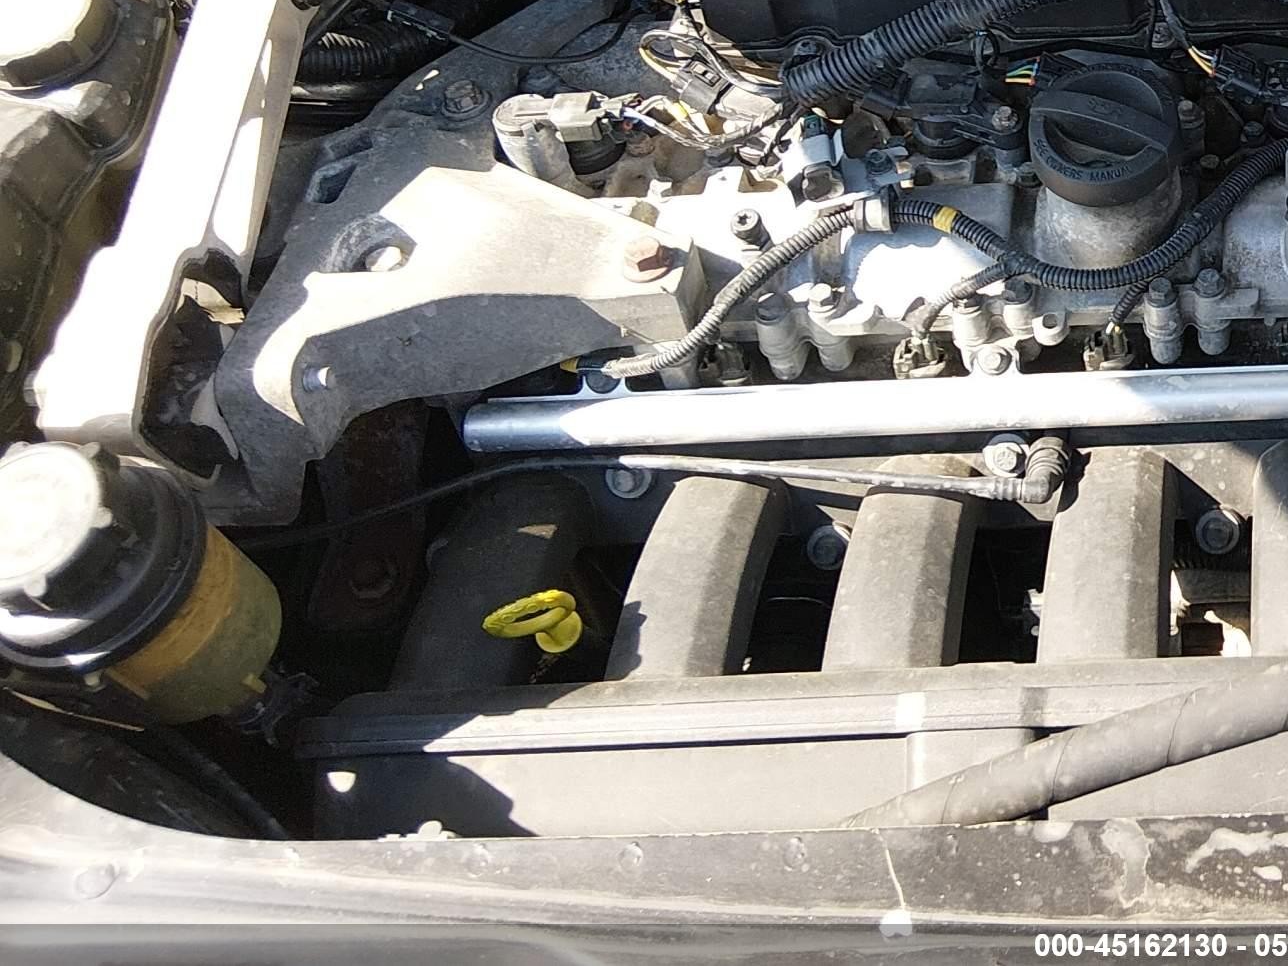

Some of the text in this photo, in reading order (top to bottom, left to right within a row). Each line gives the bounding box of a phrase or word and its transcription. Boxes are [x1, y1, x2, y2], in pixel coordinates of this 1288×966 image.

[1034, 139, 1131, 181] SEE OWNERS MANUAL
